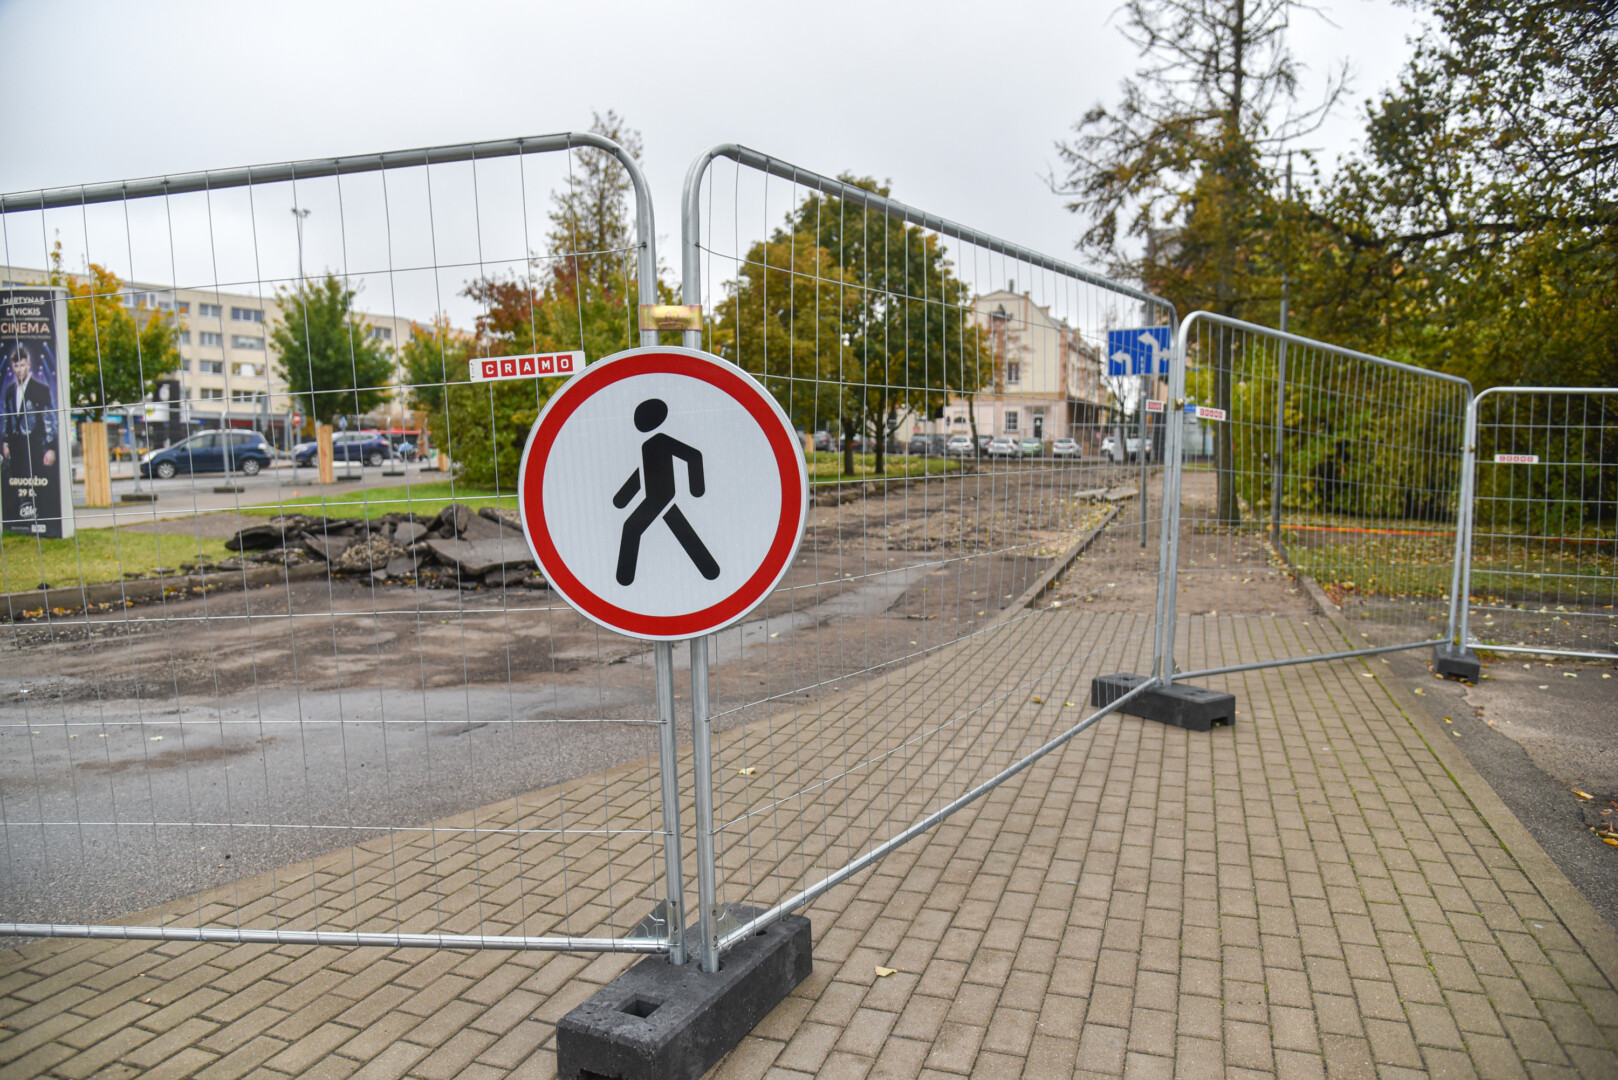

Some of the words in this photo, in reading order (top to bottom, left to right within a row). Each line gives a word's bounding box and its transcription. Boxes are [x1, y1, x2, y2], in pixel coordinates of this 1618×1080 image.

[6, 307, 41, 316] LEVICKIS
[0, 322, 50, 334] CINEMA
[484, 357, 571, 376] CRAMO
[18, 488, 28, 497] 29
